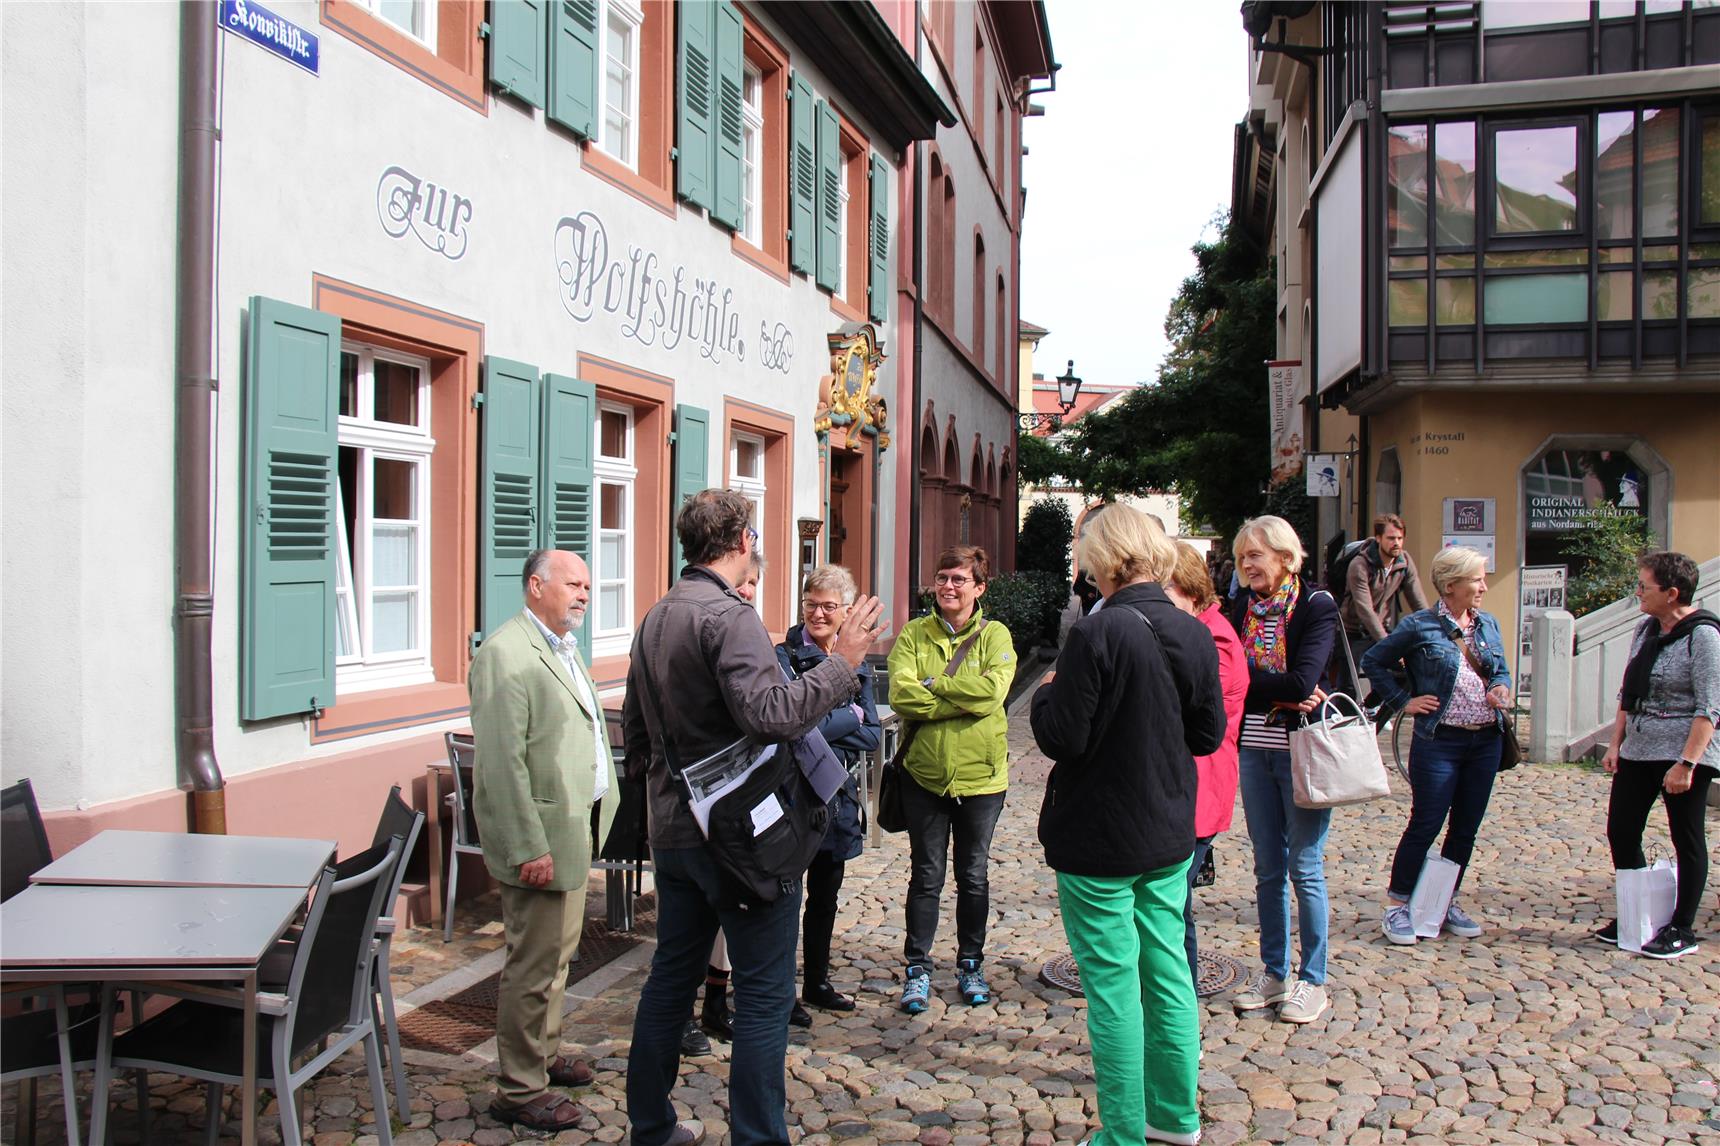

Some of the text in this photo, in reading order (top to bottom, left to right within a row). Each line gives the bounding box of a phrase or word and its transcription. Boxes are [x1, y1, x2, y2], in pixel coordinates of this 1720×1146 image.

[1284, 368, 1294, 387] Glas
[1272, 371, 1285, 433] Antiquariat &
[1425, 446, 1449, 455] 1460
[1531, 498, 1585, 507] ORIGINAL
[1531, 521, 1547, 529] aus
